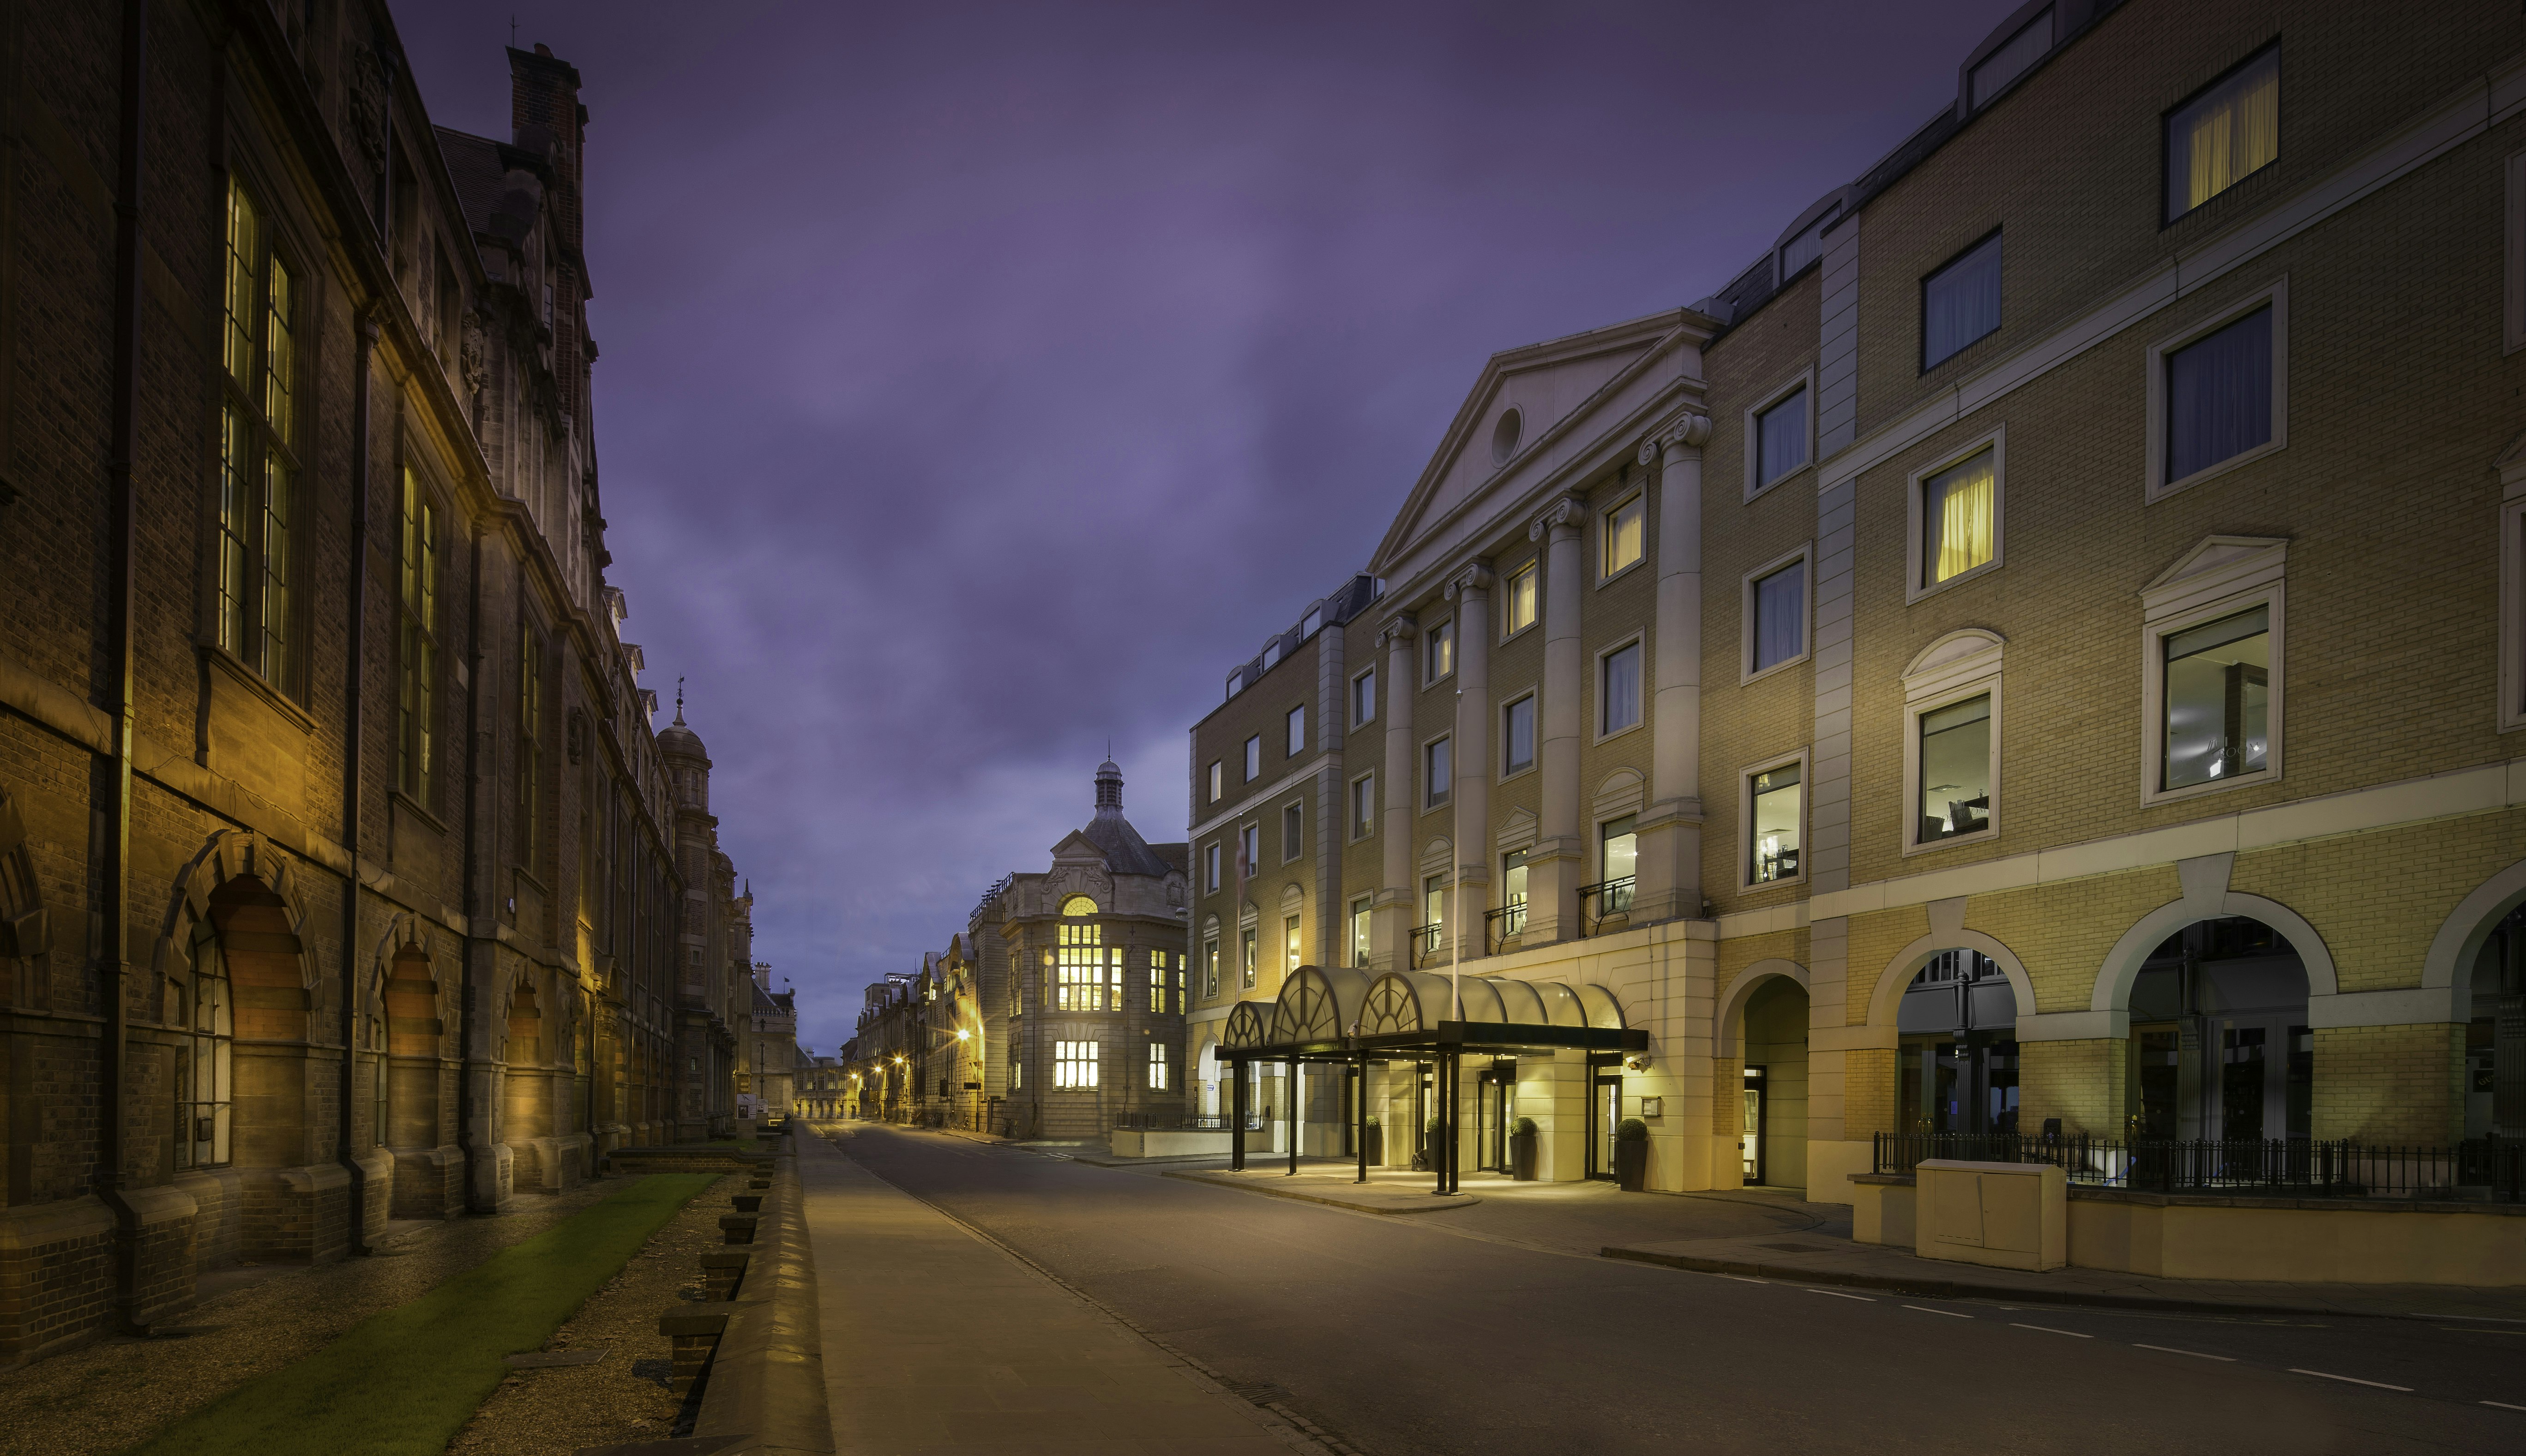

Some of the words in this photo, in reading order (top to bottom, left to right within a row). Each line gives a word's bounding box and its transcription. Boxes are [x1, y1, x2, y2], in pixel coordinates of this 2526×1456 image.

[2219, 742, 2258, 758] ROOM
[1930, 812, 1955, 825] BOOK
[1958, 805, 1986, 819] ROOM
[2478, 1075, 2494, 1085] GU
